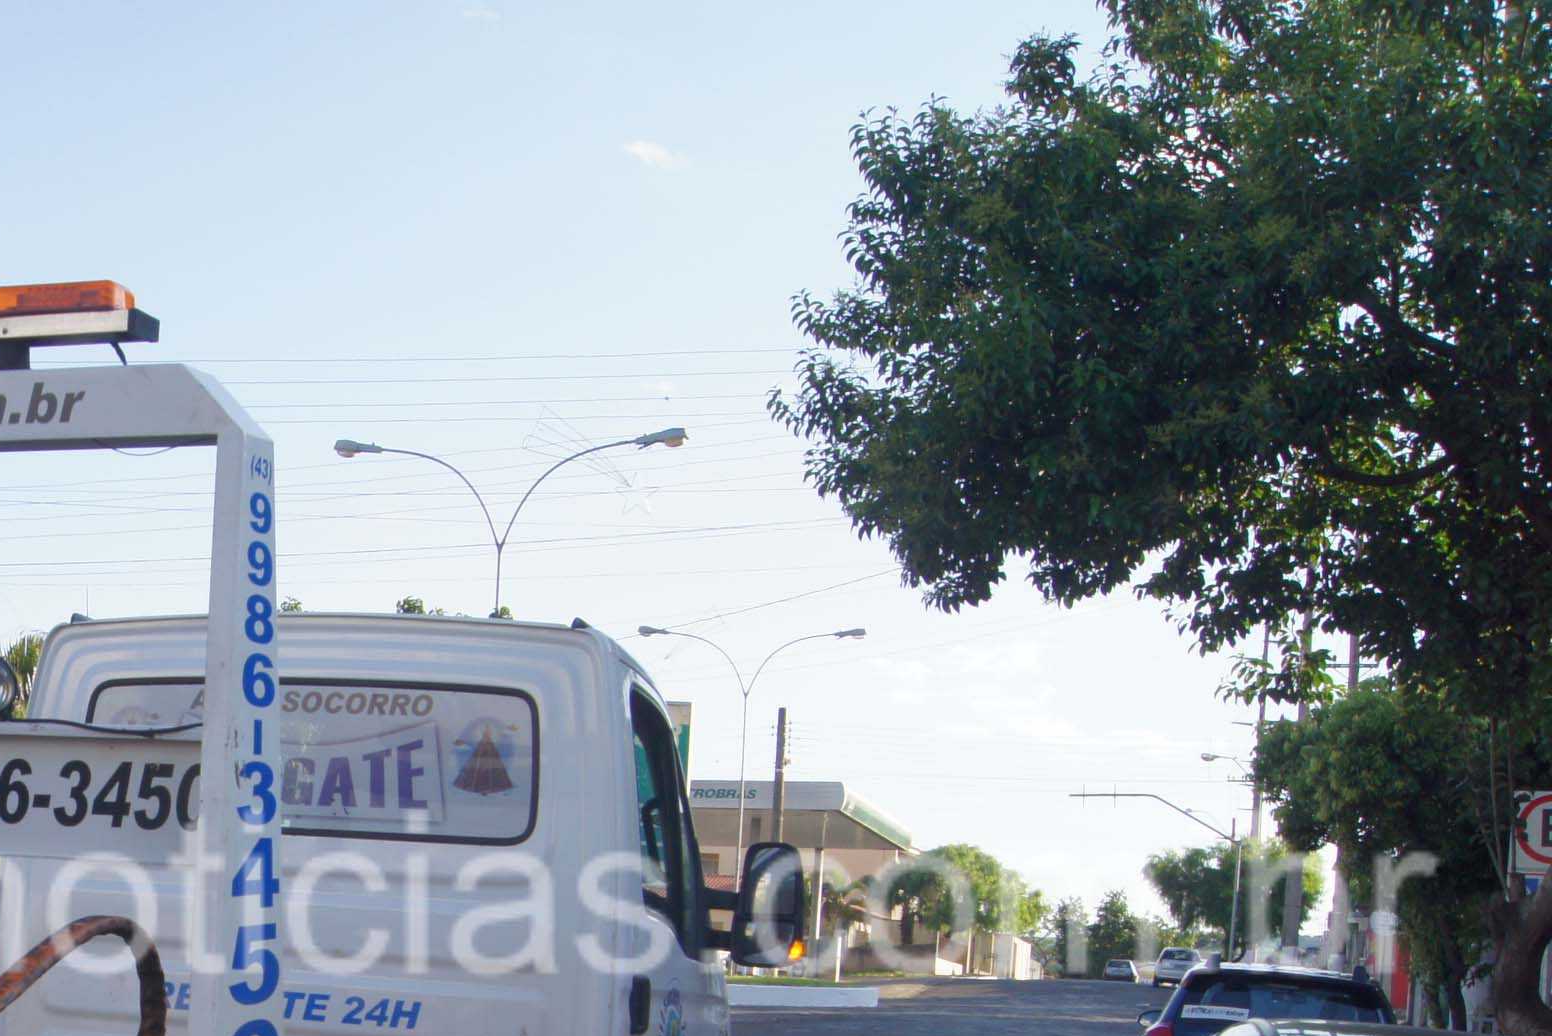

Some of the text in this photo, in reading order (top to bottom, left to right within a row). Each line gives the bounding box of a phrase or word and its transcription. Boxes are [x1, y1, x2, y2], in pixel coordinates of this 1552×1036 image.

[249, 453, 273, 484] (43)
[281, 690, 434, 717] SOCORRO
[341, 995, 421, 1029] 24H
